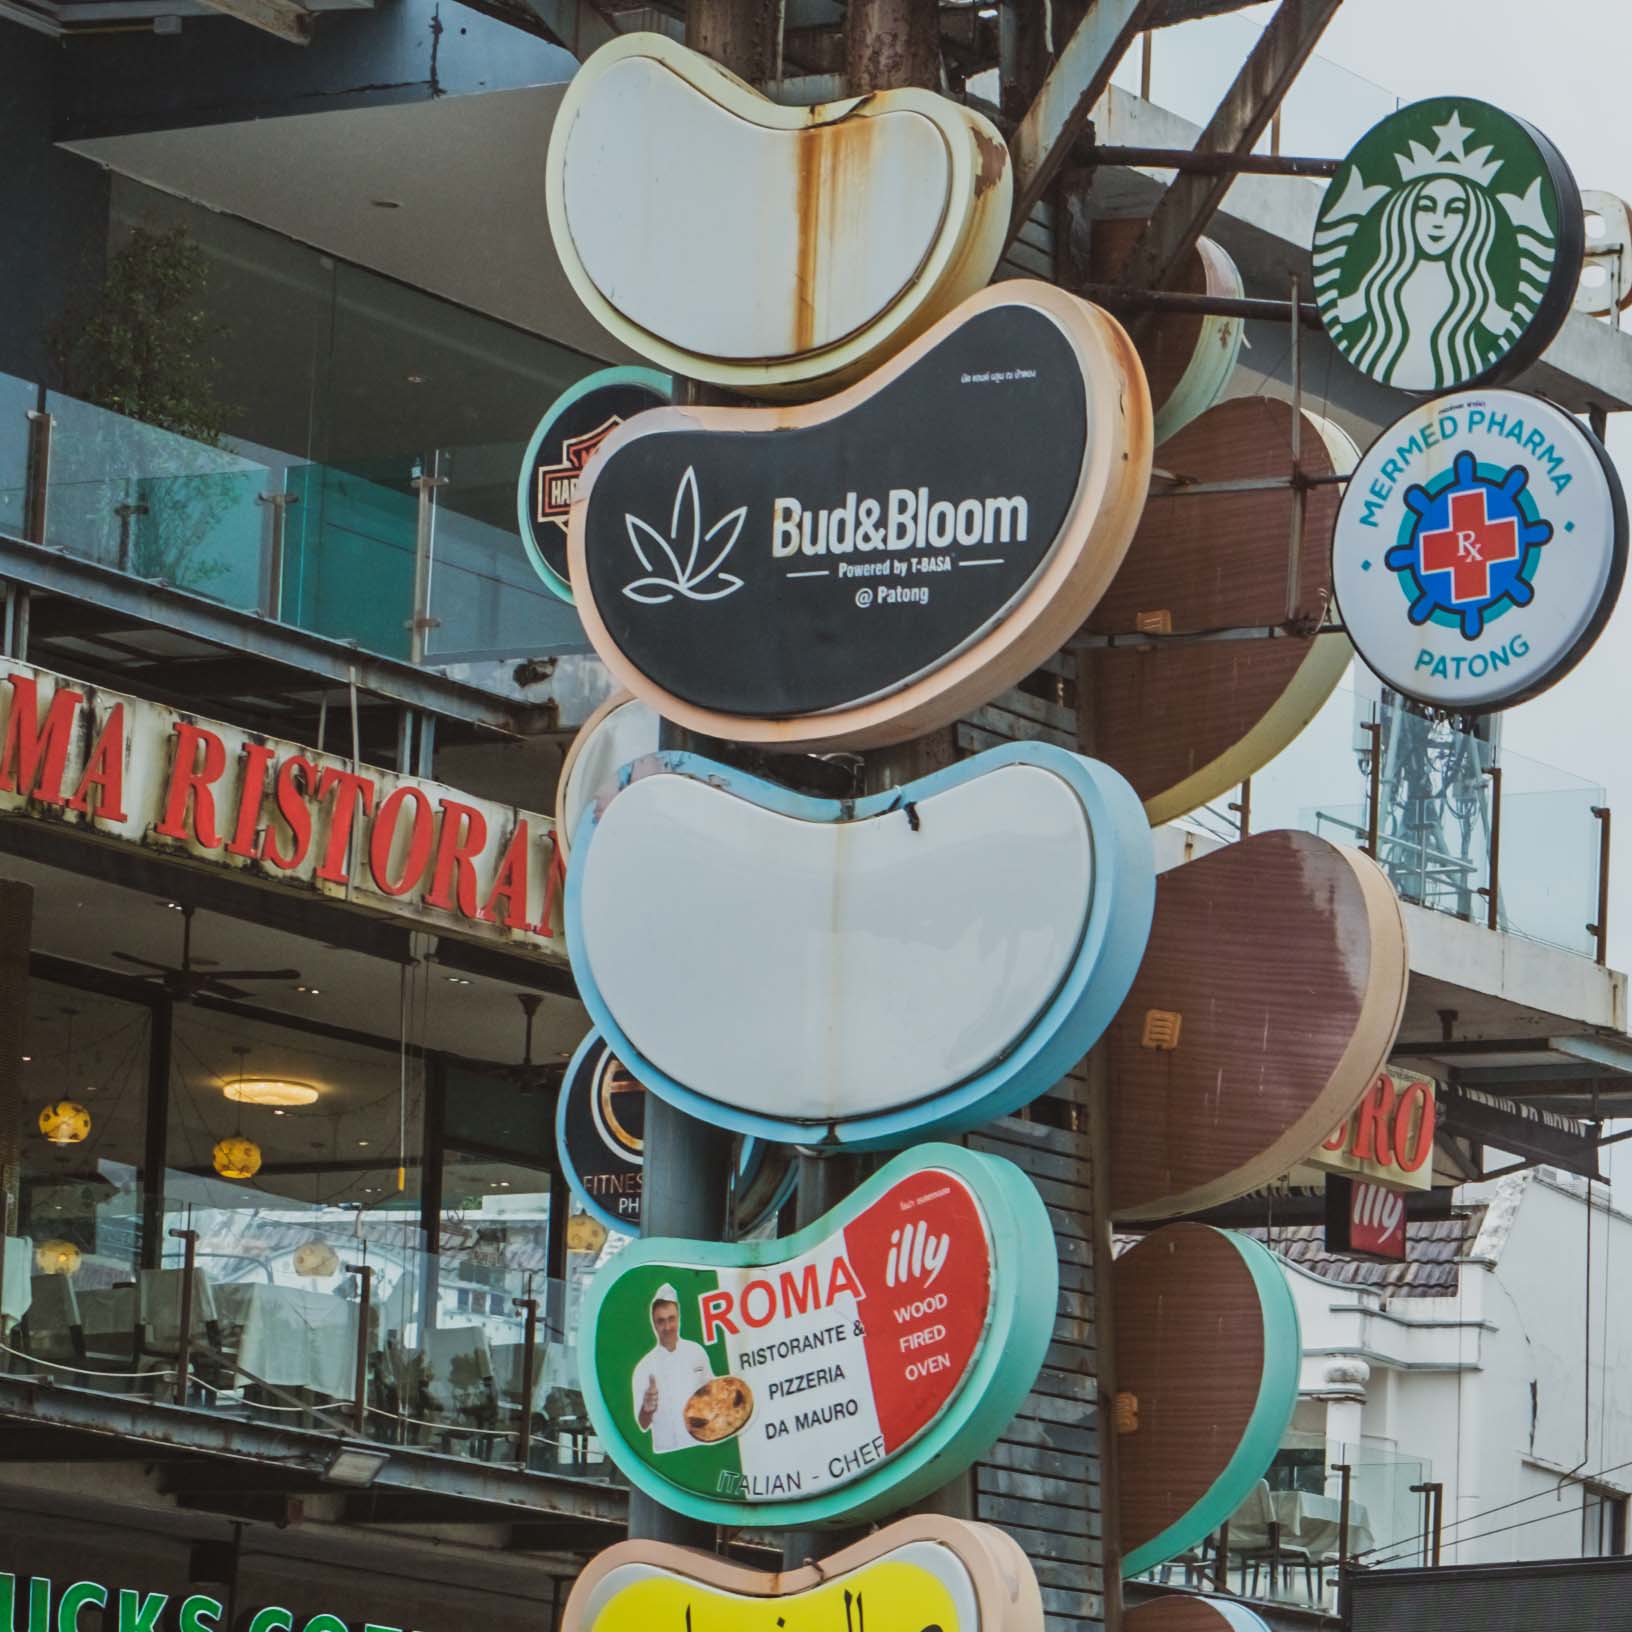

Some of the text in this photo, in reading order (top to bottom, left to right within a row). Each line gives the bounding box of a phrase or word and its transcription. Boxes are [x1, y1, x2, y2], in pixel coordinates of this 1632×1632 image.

[1359, 409, 1573, 528] MERMED PHARMA
[772, 486, 1028, 559] Bud&Bloom
[838, 556, 951, 578] Powered by T-BASA
[855, 586, 929, 608] @ Patong
[1414, 634, 1531, 681] PATONG
[886, 1220, 951, 1289] illy
[698, 1255, 866, 1345] ROMA
[894, 1293, 948, 1324] WOOD
[739, 1319, 866, 1371] RISTORANTE &
[899, 1325, 946, 1353] FIRED
[768, 1364, 845, 1401] PIZZERIA
[904, 1353, 951, 1382] OVEN
[765, 1398, 859, 1441] DA MAURO
[716, 1434, 886, 1497] ITALIAN CHEF
